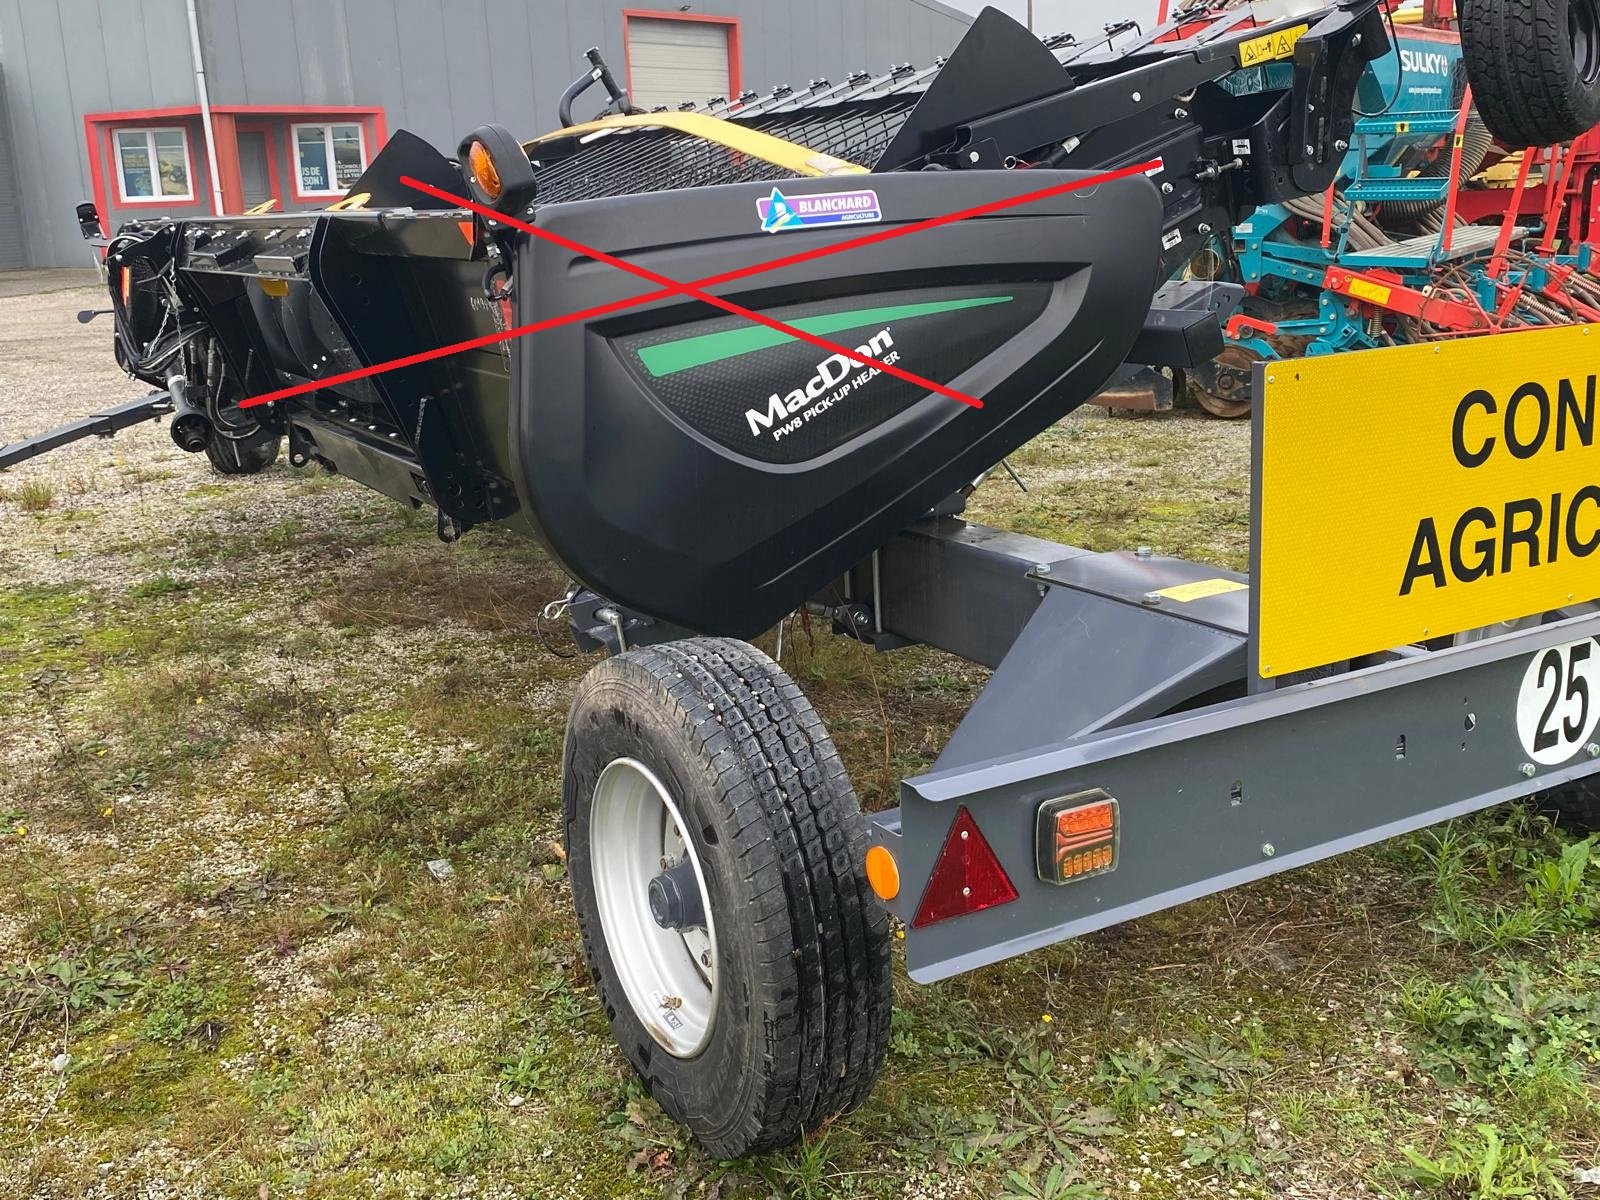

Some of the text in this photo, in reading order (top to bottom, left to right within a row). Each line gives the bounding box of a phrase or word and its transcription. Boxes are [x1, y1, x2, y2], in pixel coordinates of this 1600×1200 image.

[1400, 49, 1441, 74] SULKY
[798, 196, 872, 213] BLANCHARD
[841, 212, 875, 221] AGRICULTURE
[745, 328, 894, 436] MacDon
[772, 350, 901, 442] PW8 PICK-UP HEAER
[1452, 374, 1597, 469] CON
[1398, 485, 1600, 597] AGRIC
[1533, 641, 1592, 753] 25
